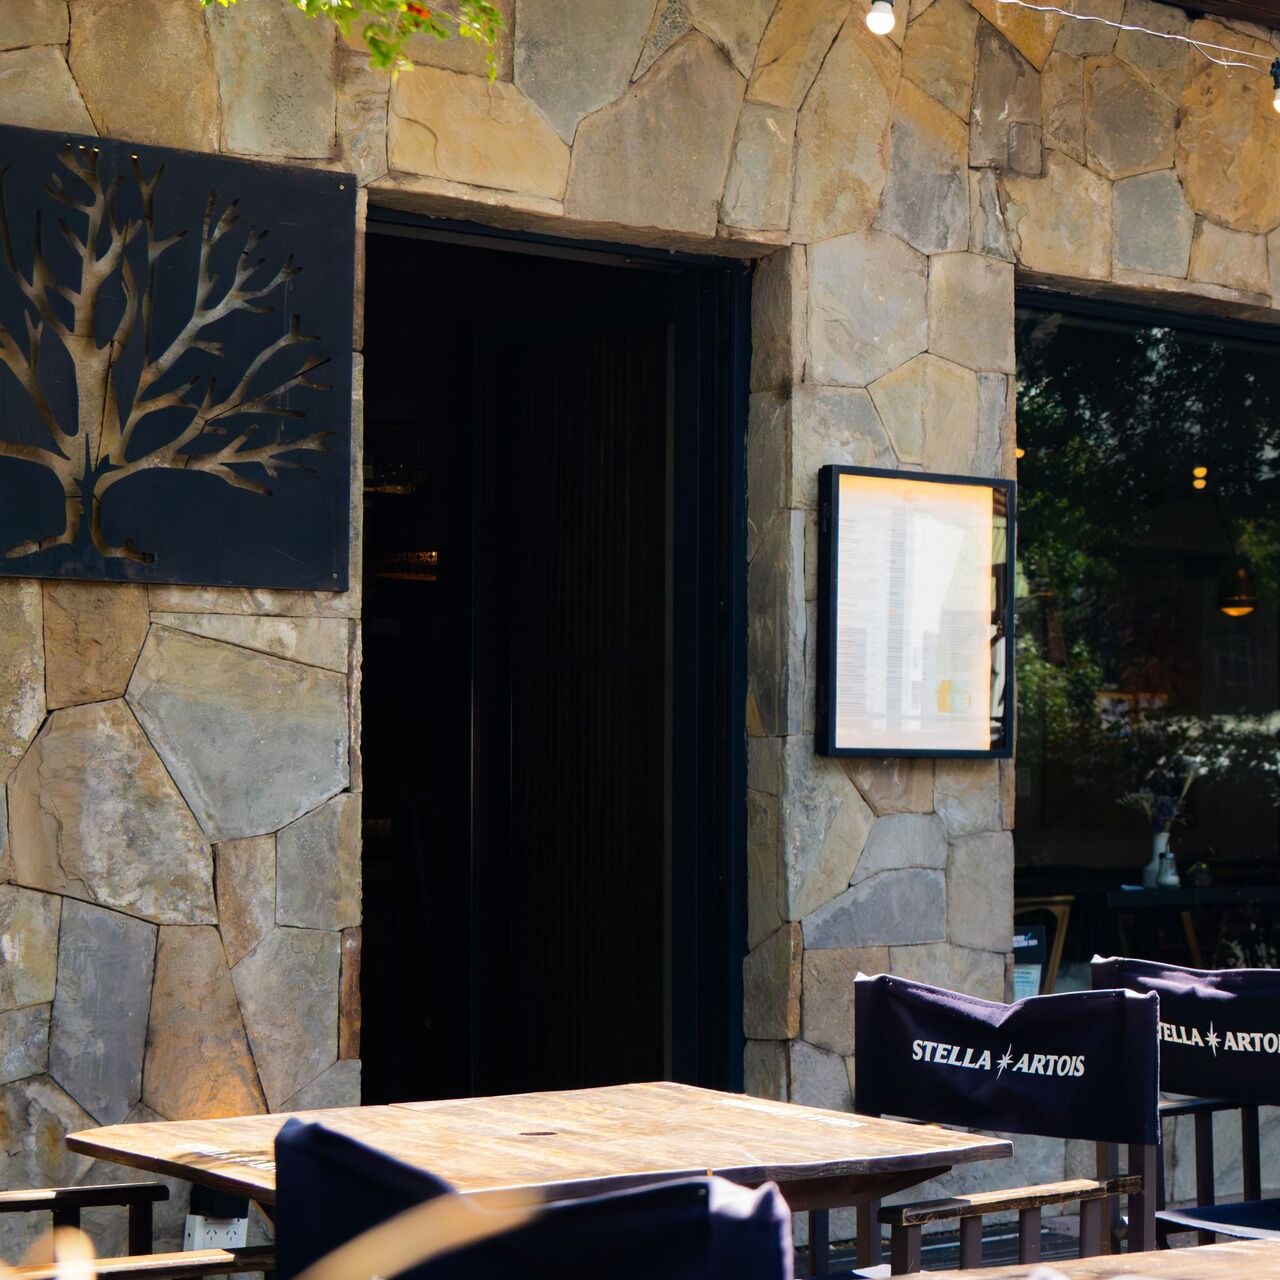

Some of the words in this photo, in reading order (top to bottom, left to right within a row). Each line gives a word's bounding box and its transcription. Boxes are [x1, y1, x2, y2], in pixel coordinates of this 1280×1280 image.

[1159, 1021, 1205, 1047] TELLA
[912, 1039, 992, 1071] STELLA
[1012, 1053, 1085, 1078] ARTOIS
